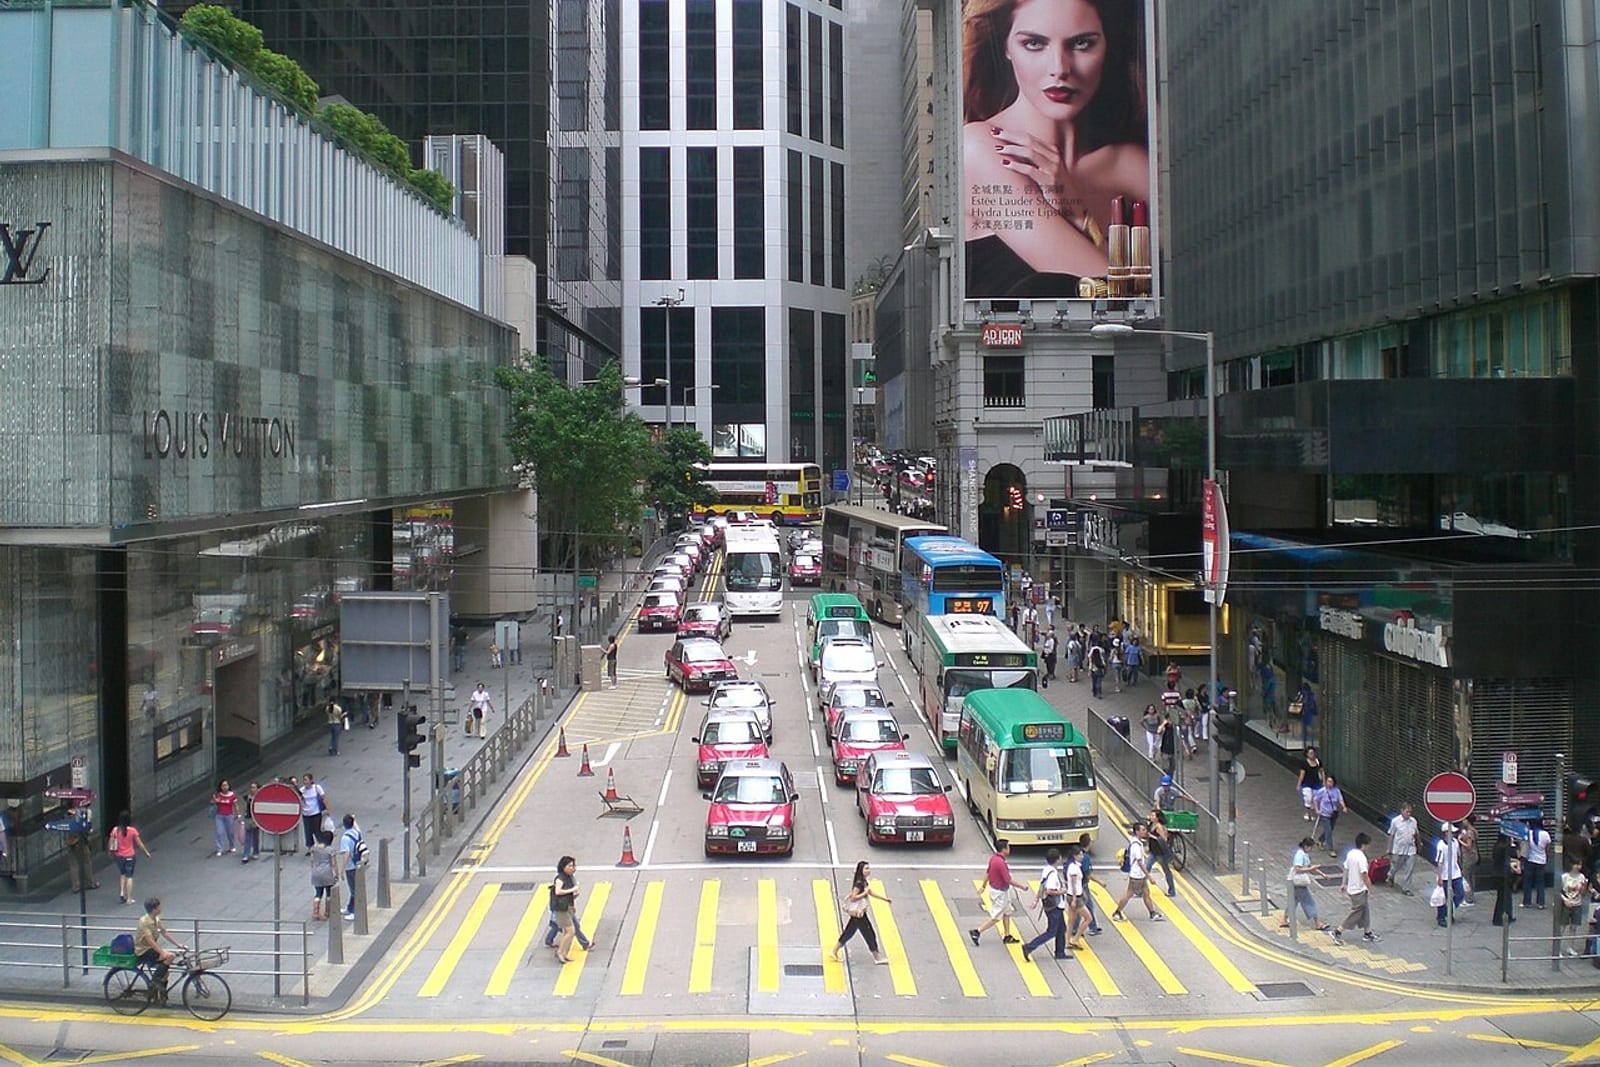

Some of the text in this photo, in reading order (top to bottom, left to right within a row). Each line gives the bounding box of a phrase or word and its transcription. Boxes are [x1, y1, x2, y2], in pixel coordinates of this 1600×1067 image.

[971, 208, 1001, 220] Hydra
[1005, 208, 1034, 217] Lustre
[999, 196, 1033, 206] Lauder
[142, 409, 296, 460] LOUIS VUITTON
[968, 459, 977, 533] SHANGHAI TANG
[977, 601, 990, 613] 97
[1384, 617, 1448, 668] citibank
